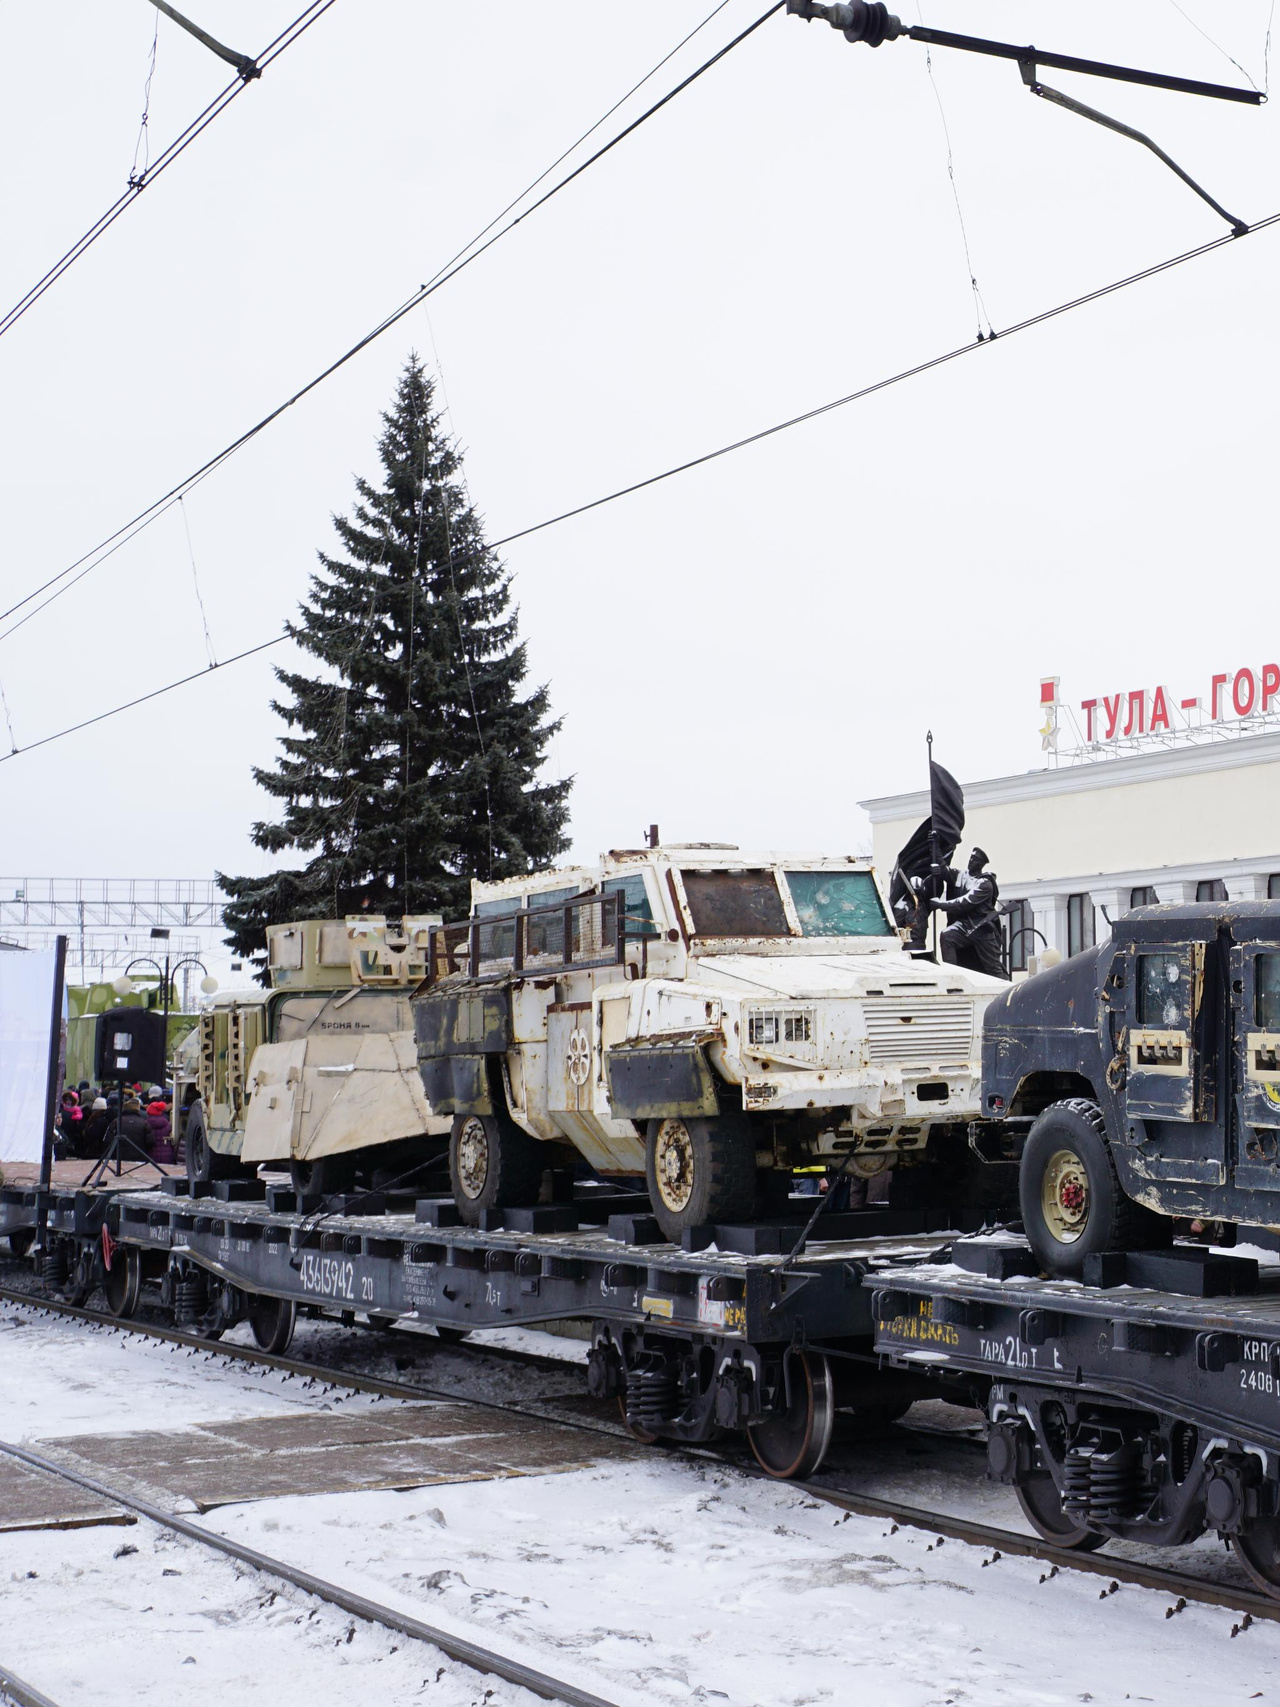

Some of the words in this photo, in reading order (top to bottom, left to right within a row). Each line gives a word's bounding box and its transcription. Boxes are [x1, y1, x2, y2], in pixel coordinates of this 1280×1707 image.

[1081, 685, 1174, 743] ТУЛА
[321, 1022, 352, 1030] БРОНЯ
[300, 1254, 354, 1300] 43613942
[361, 1276, 374, 1301] 20
[979, 1338, 1006, 1364] ТАРА
